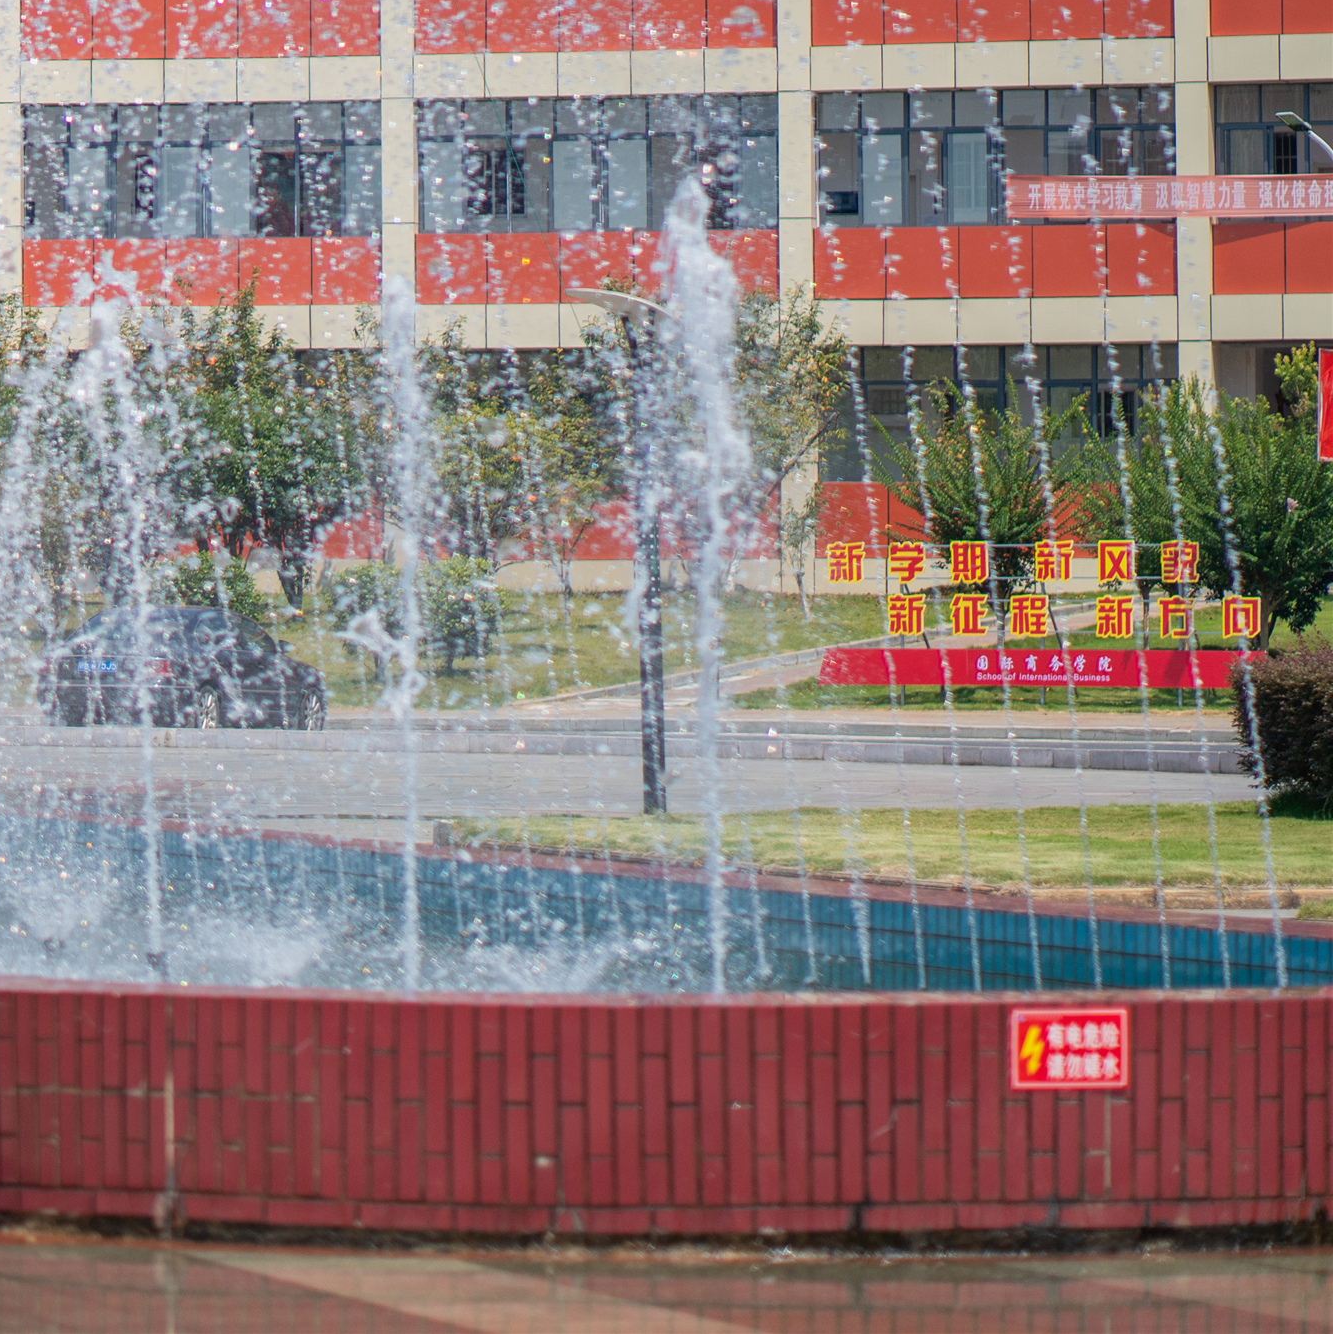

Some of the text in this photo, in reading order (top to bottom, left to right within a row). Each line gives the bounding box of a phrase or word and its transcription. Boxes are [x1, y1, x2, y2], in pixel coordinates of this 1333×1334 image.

[1028, 182, 1143, 211] 开展党史学习教育
[1155, 180, 1246, 209] 汲取智慧力量
[827, 539, 1200, 584] 新学期 新风貌
[888, 594, 1262, 639] 新征程 新方向
[976, 654, 1113, 672] 国际商务学院
[1008, 672, 1017, 681] of
[1019, 673, 1069, 682] International
[1073, 673, 1110, 682] Business
[1046, 1021, 1119, 1049] 有电危险
